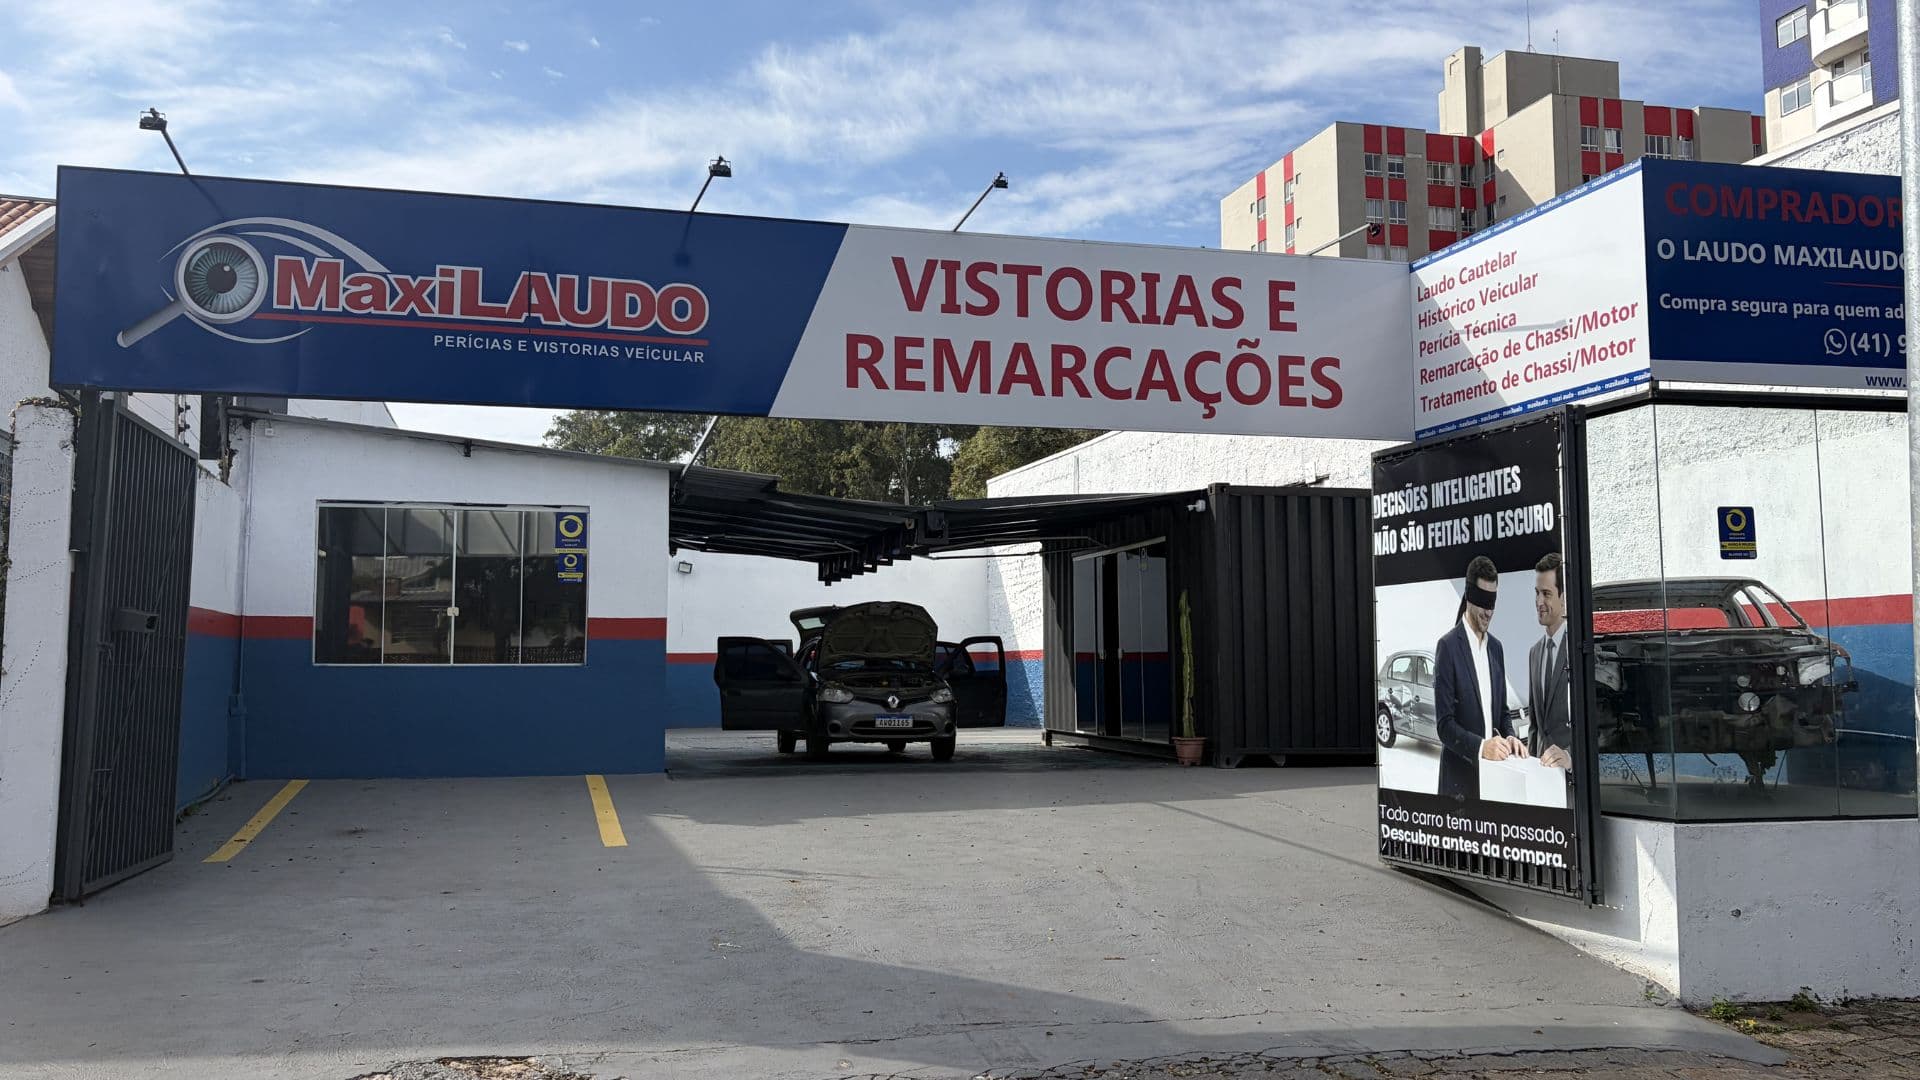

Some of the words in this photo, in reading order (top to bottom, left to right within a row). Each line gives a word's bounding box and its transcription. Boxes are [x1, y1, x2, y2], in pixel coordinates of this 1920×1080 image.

[1665, 182, 1903, 229] COMPRADOR
[1417, 274, 1455, 302] Laudo
[1458, 250, 1517, 285] Cautelar
[1657, 238, 1675, 260] O
[1683, 240, 1766, 265] LAUDO
[273, 254, 710, 335] MaxiLAUDO
[891, 256, 1245, 330] VISTORIAS
[1268, 280, 1298, 333] E
[1418, 299, 1475, 330] Histórico
[1479, 272, 1538, 306] Veicular
[1659, 293, 1727, 315] Compra
[1731, 297, 1788, 317] segura
[1793, 303, 1829, 318] para
[1834, 304, 1880, 320] quem
[434, 334, 513, 352] PERÍCIAS
[518, 341, 528, 352] E
[533, 340, 619, 359] VISTORIAS
[625, 344, 705, 363] VEÍCULAR
[1419, 329, 1460, 358] Perícia
[1464, 312, 1516, 342] Técnica
[1420, 348, 1498, 385] Remarcação
[1504, 339, 1521, 359] de
[1525, 300, 1639, 352] Chassi/Motor
[1850, 332, 1890, 357] (41)
[846, 333, 1343, 419] REMARCAÇÕES
[1420, 379, 1497, 413] Tratamento
[1501, 368, 1519, 388] de
[1523, 336, 1636, 383] Chassi/Motor
[1865, 376, 1907, 388] www.
[1373, 482, 1427, 519] DECISÕES
[1431, 465, 1521, 509] INTELIGENTES
[1374, 525, 1397, 556] NÃO
[1400, 520, 1424, 552] SÃO
[1428, 517, 1470, 549] FEITAS
[1474, 513, 1493, 542] NO
[1497, 502, 1554, 539] ESCURO
[1379, 804, 1409, 823] Todo
[1411, 811, 1443, 828] carro
[1446, 814, 1472, 832] tem
[1475, 820, 1497, 836] um
[1501, 822, 1568, 848] passado,
[1381, 824, 1439, 847] Descubra
[1442, 836, 1479, 854] antes
[1482, 840, 1500, 858] da
[1503, 846, 1567, 869] compra.
